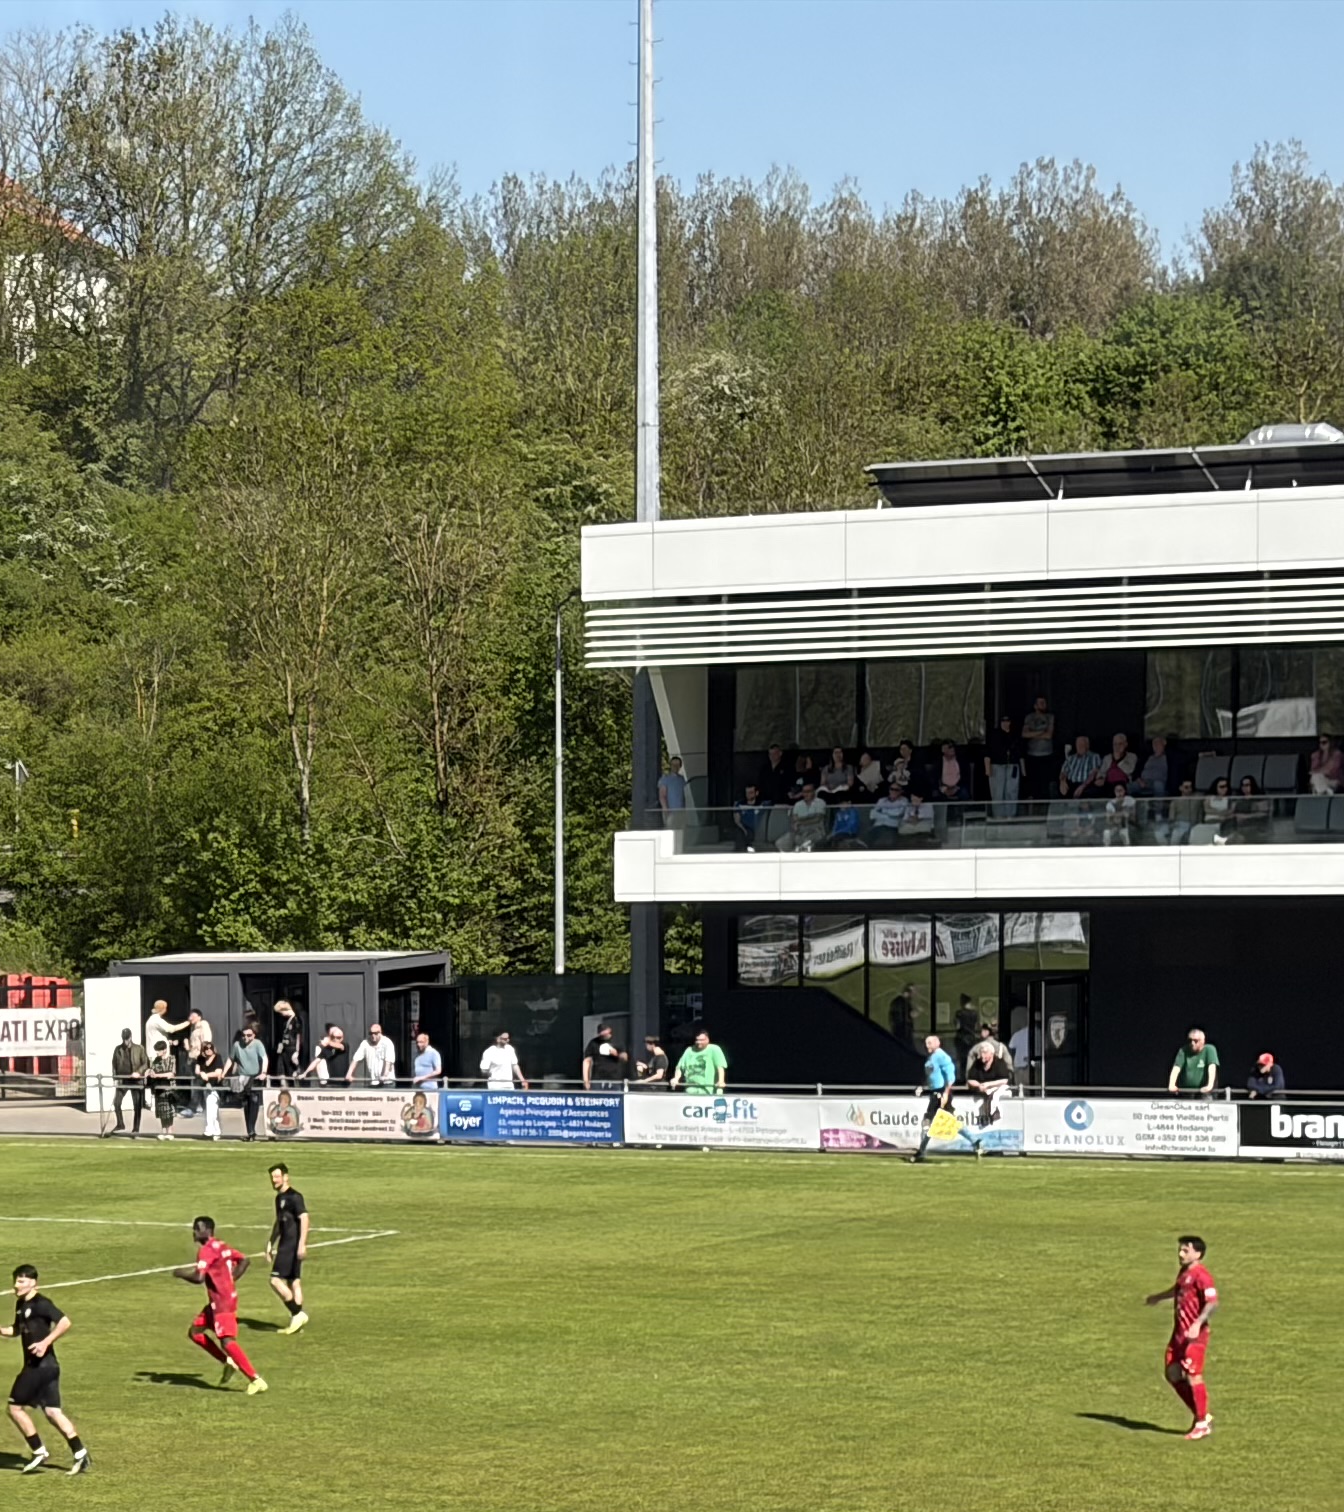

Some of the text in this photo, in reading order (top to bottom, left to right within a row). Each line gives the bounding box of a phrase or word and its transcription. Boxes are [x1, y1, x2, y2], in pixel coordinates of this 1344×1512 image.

[34, 1018, 80, 1042] EXPO
[682, 1098, 758, 1120] car fit
[449, 1113, 482, 1130] Foyer
[869, 1110, 919, 1126] Claude
[1034, 1134, 1126, 1146] CLEANOLUX
